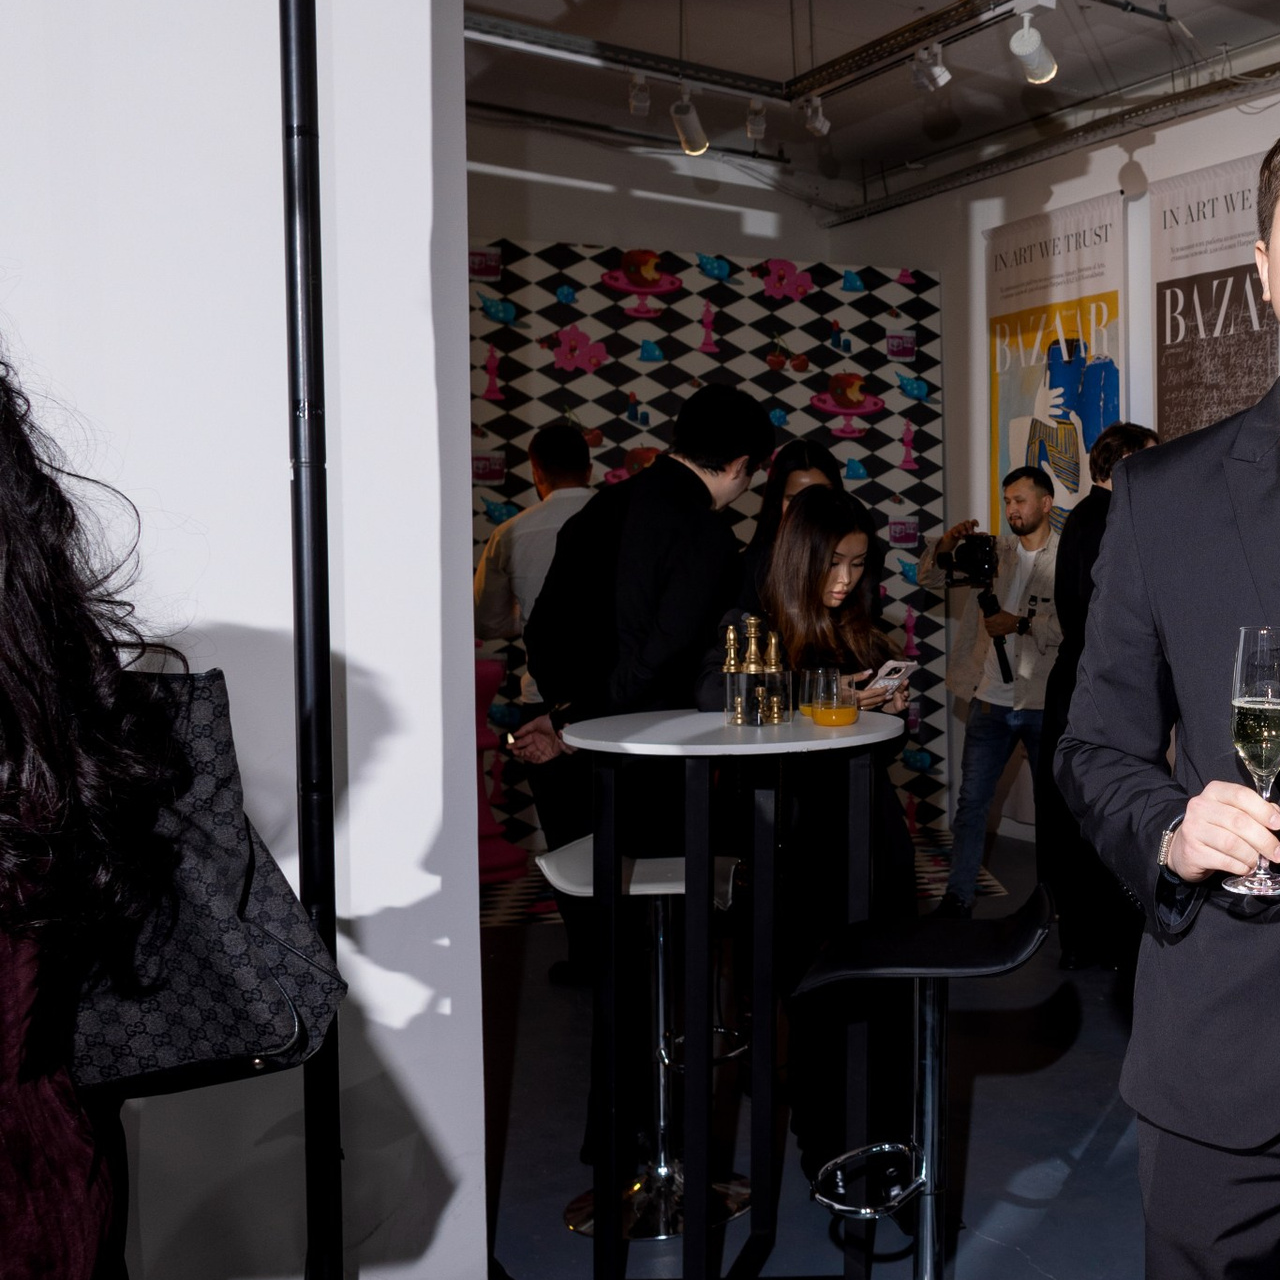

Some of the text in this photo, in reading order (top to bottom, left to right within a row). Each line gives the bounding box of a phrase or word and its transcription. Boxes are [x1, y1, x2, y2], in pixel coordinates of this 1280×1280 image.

[1162, 188, 1253, 230] IN ART WE
[994, 223, 1113, 273] IN ART WE TRUST
[994, 301, 1111, 373] BAZAAR
